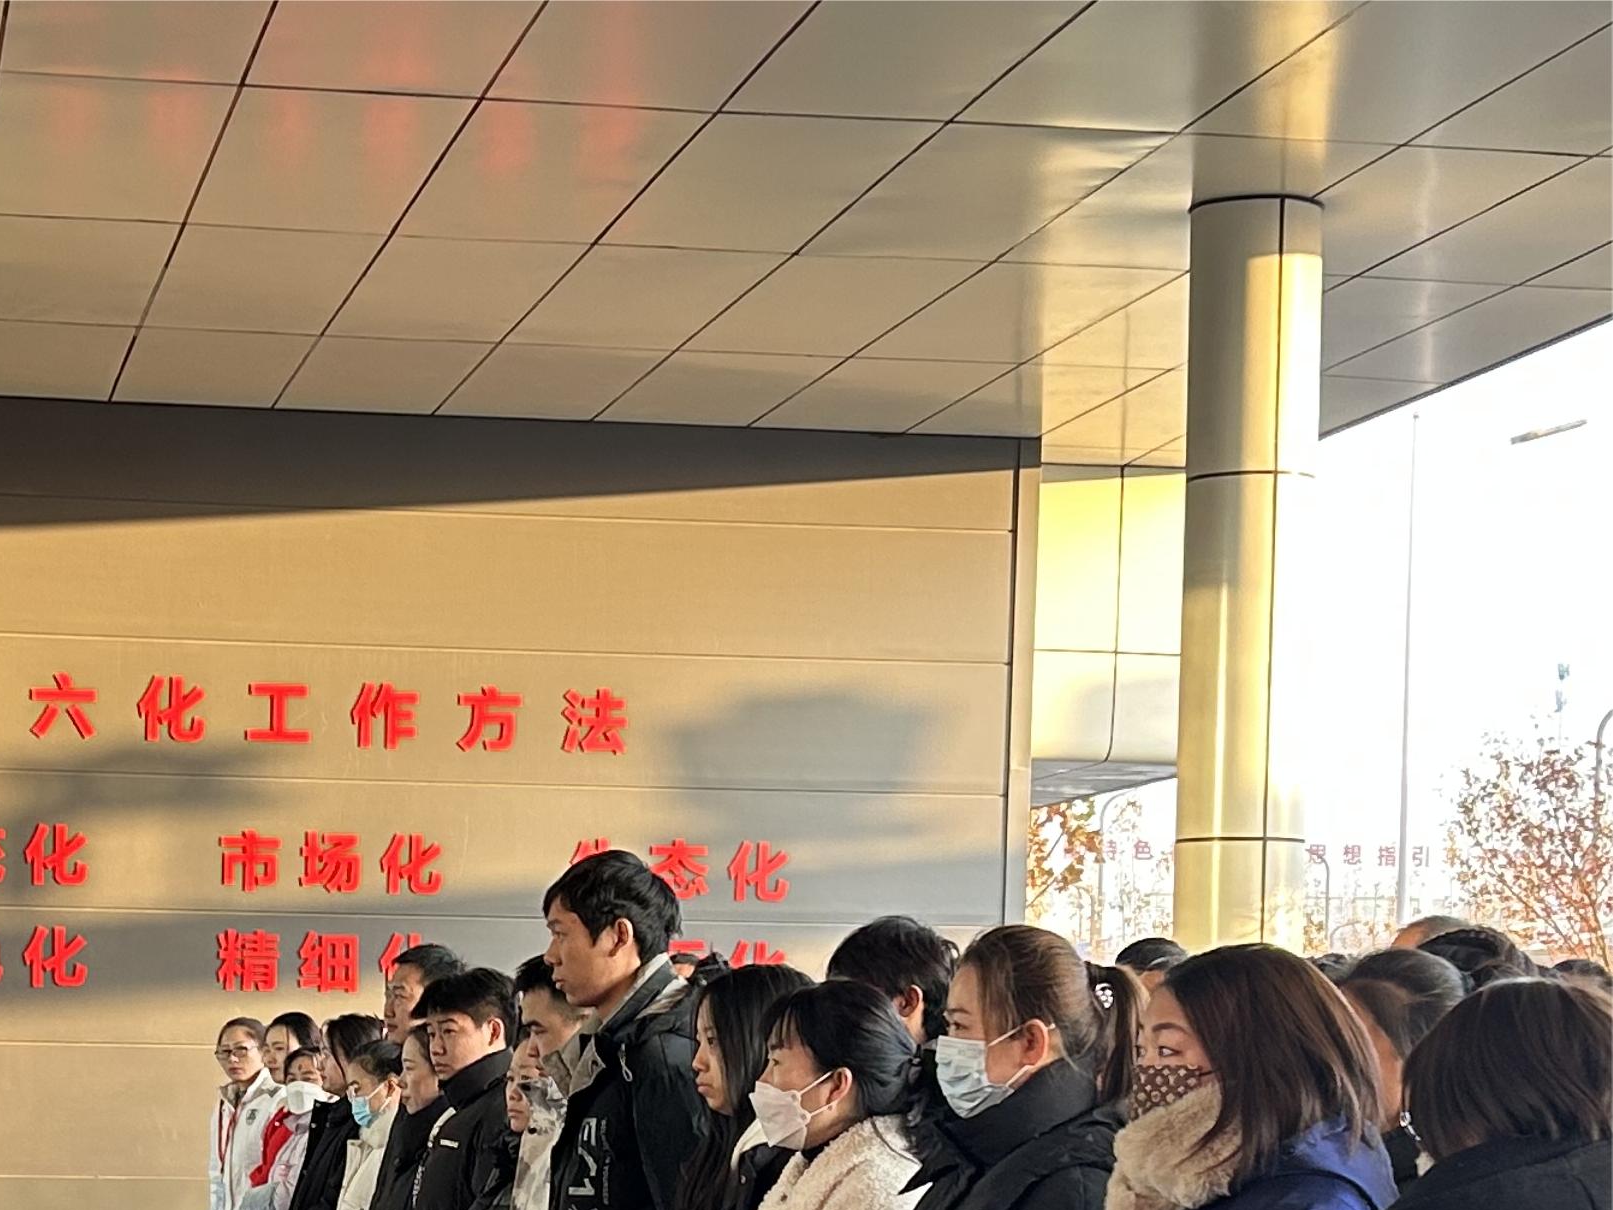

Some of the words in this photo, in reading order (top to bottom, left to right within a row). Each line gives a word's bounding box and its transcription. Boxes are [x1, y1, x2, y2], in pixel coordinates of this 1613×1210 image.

[29, 672, 630, 757] 六化工作方法
[219, 828, 445, 897] 市场化
[569, 837, 790, 902] 态化
